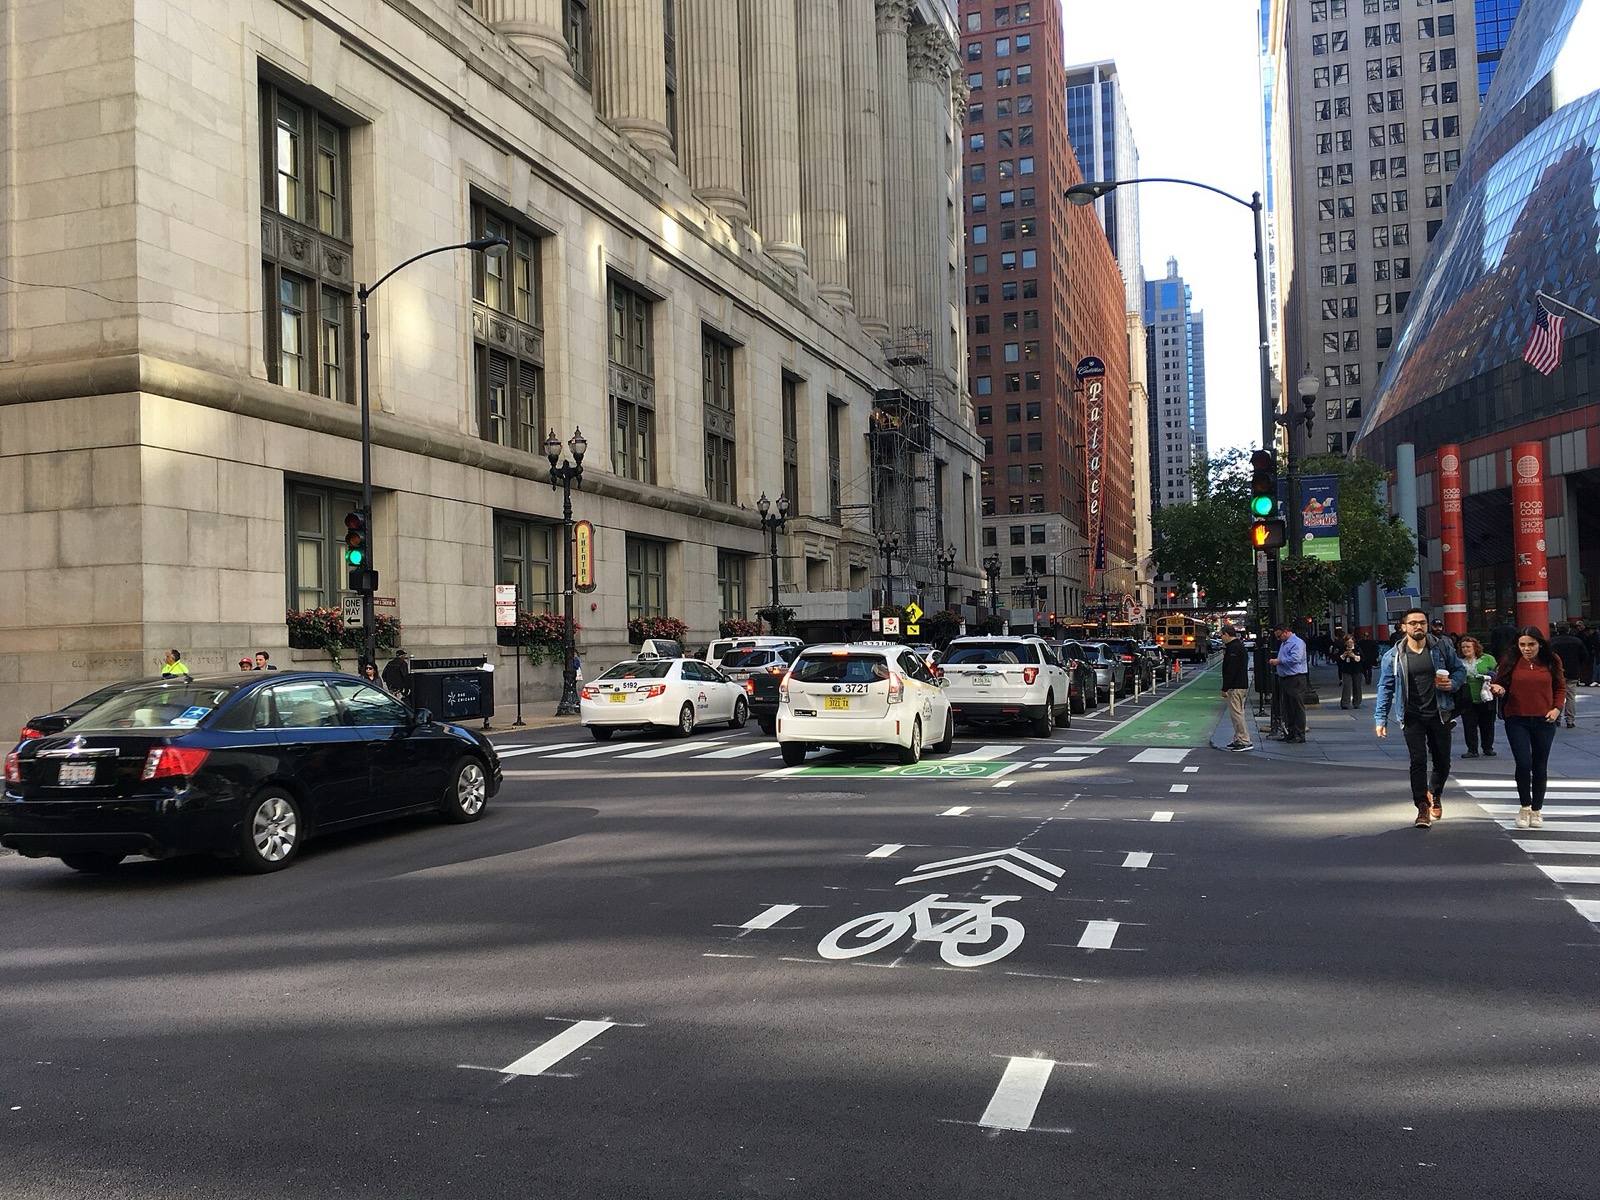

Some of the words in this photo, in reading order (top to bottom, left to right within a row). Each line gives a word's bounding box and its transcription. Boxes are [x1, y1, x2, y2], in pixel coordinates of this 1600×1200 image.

[1089, 382, 1102, 514] Palace
[1520, 508, 1542, 516] COURT
[345, 599, 361, 607] ONE
[427, 659, 472, 668] NEWSPAPERS
[845, 684, 869, 693] 3721
